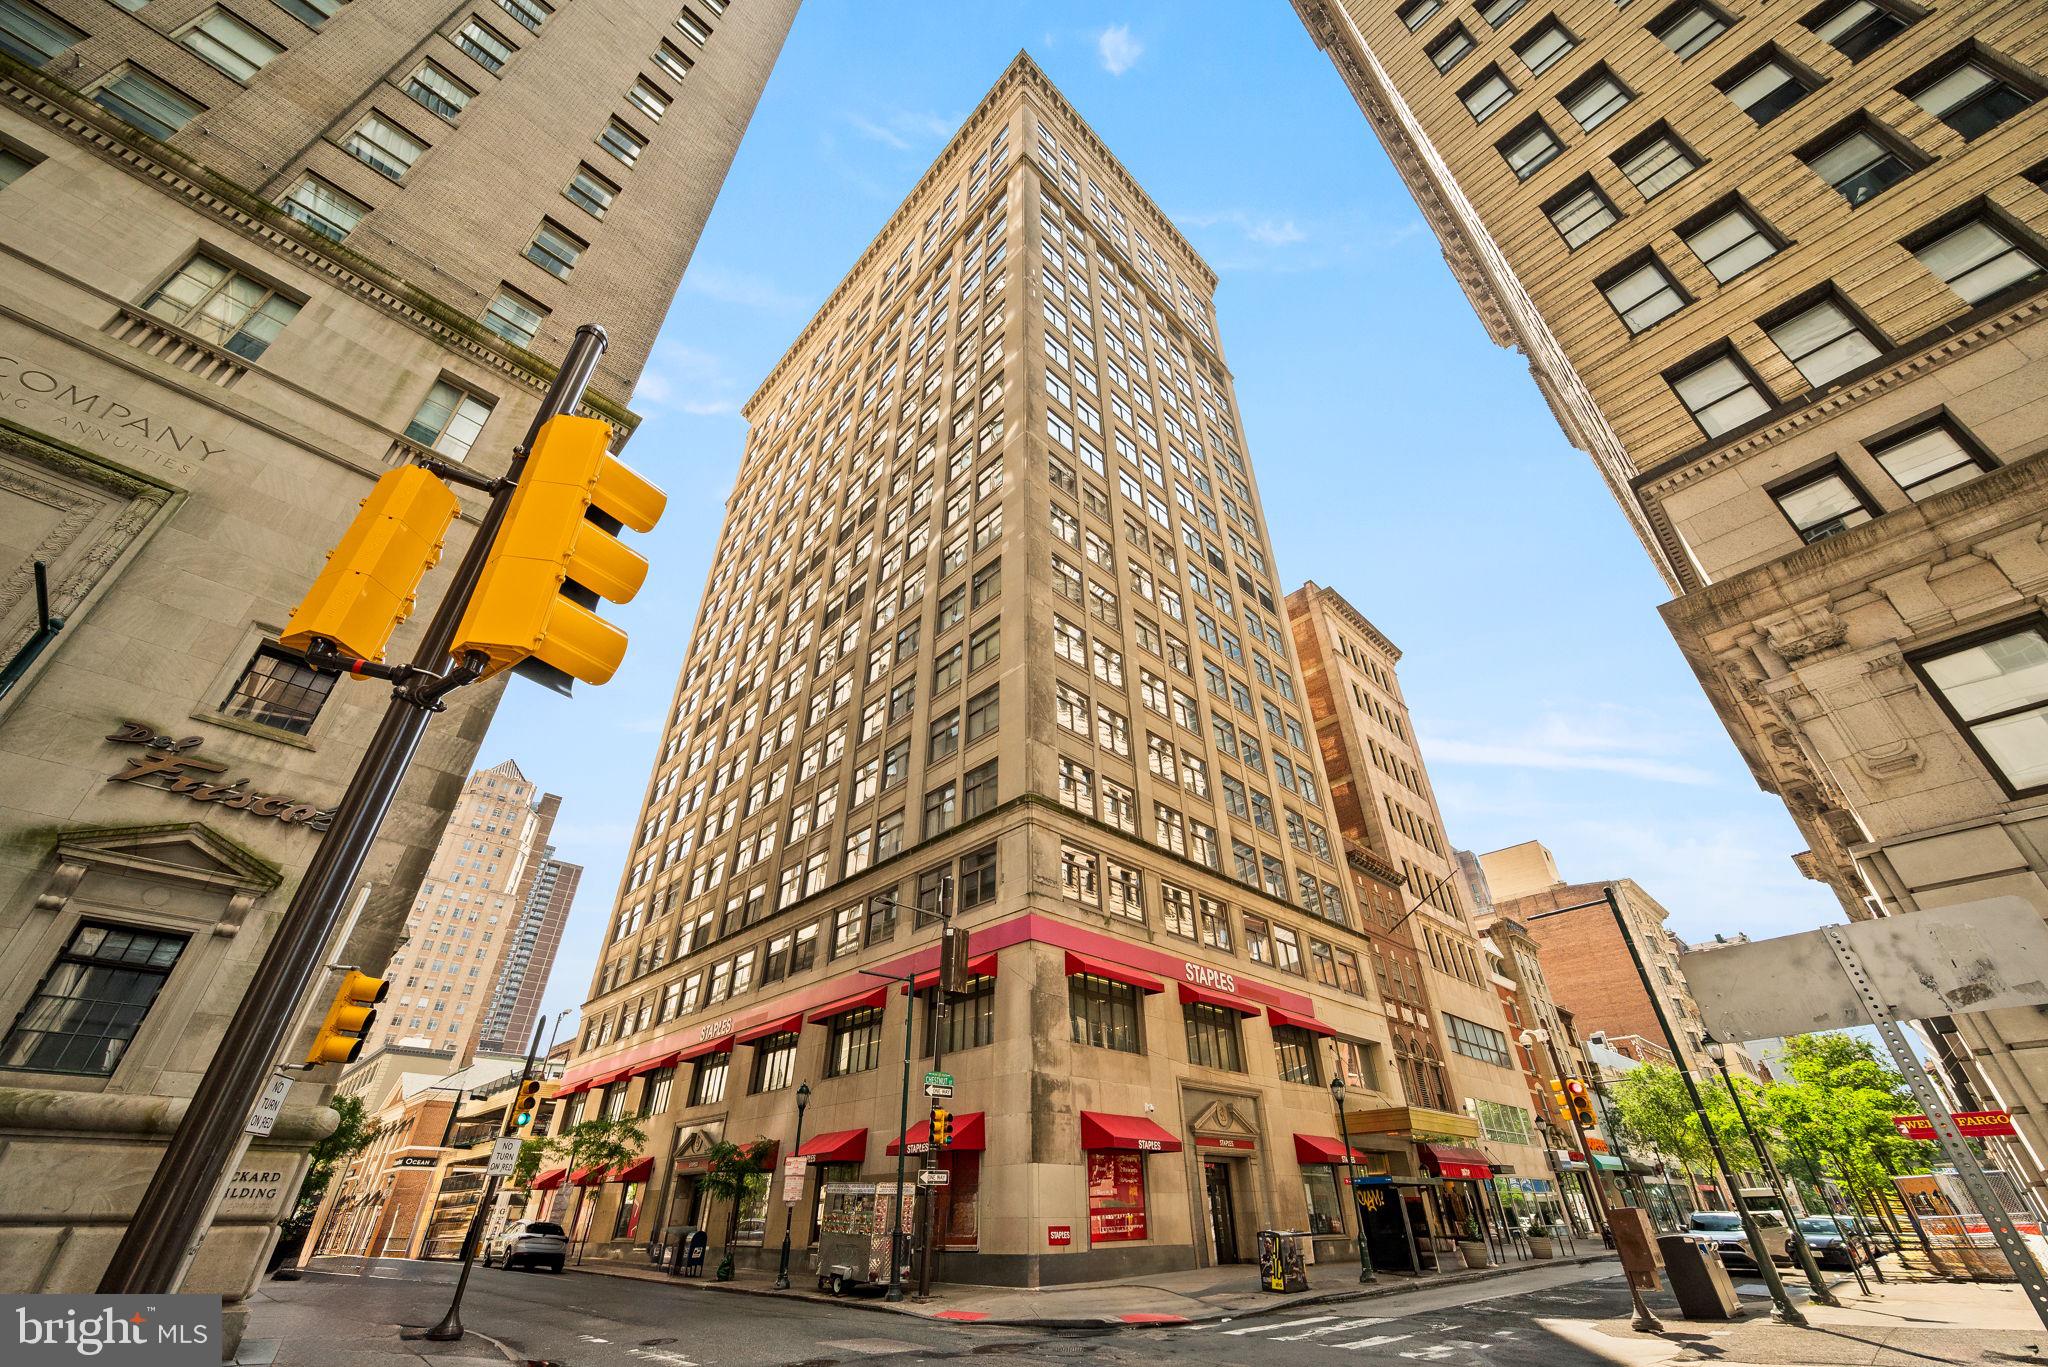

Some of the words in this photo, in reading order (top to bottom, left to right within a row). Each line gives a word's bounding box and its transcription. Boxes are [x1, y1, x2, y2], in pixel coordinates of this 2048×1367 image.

[52, 416, 191, 475] ANNUITIES
[105, 720, 205, 753] Del
[1185, 962, 1235, 993] STAPLES
[701, 1017, 733, 1041] STAPLES
[926, 1076, 948, 1086] CHESTNUT
[271, 1081, 284, 1094] NO
[261, 1097, 281, 1112] TURN
[250, 1114, 261, 1127] ON
[259, 1116, 274, 1129] RED
[1955, 1114, 2010, 1127] FARGO
[502, 1142, 514, 1151] NO
[906, 1143, 930, 1154] STAPLES
[1138, 1140, 1161, 1151] STAPLES
[1219, 1139, 1235, 1147] STAPLES
[405, 1158, 430, 1166] OCEAN
[496, 1152, 515, 1161] TURN
[490, 1162, 500, 1171] ON
[501, 1163, 513, 1172] RED
[928, 1173, 937, 1181] ONE
[937, 1174, 947, 1182] WAY
[1050, 1231, 1071, 1240] STAPLES
